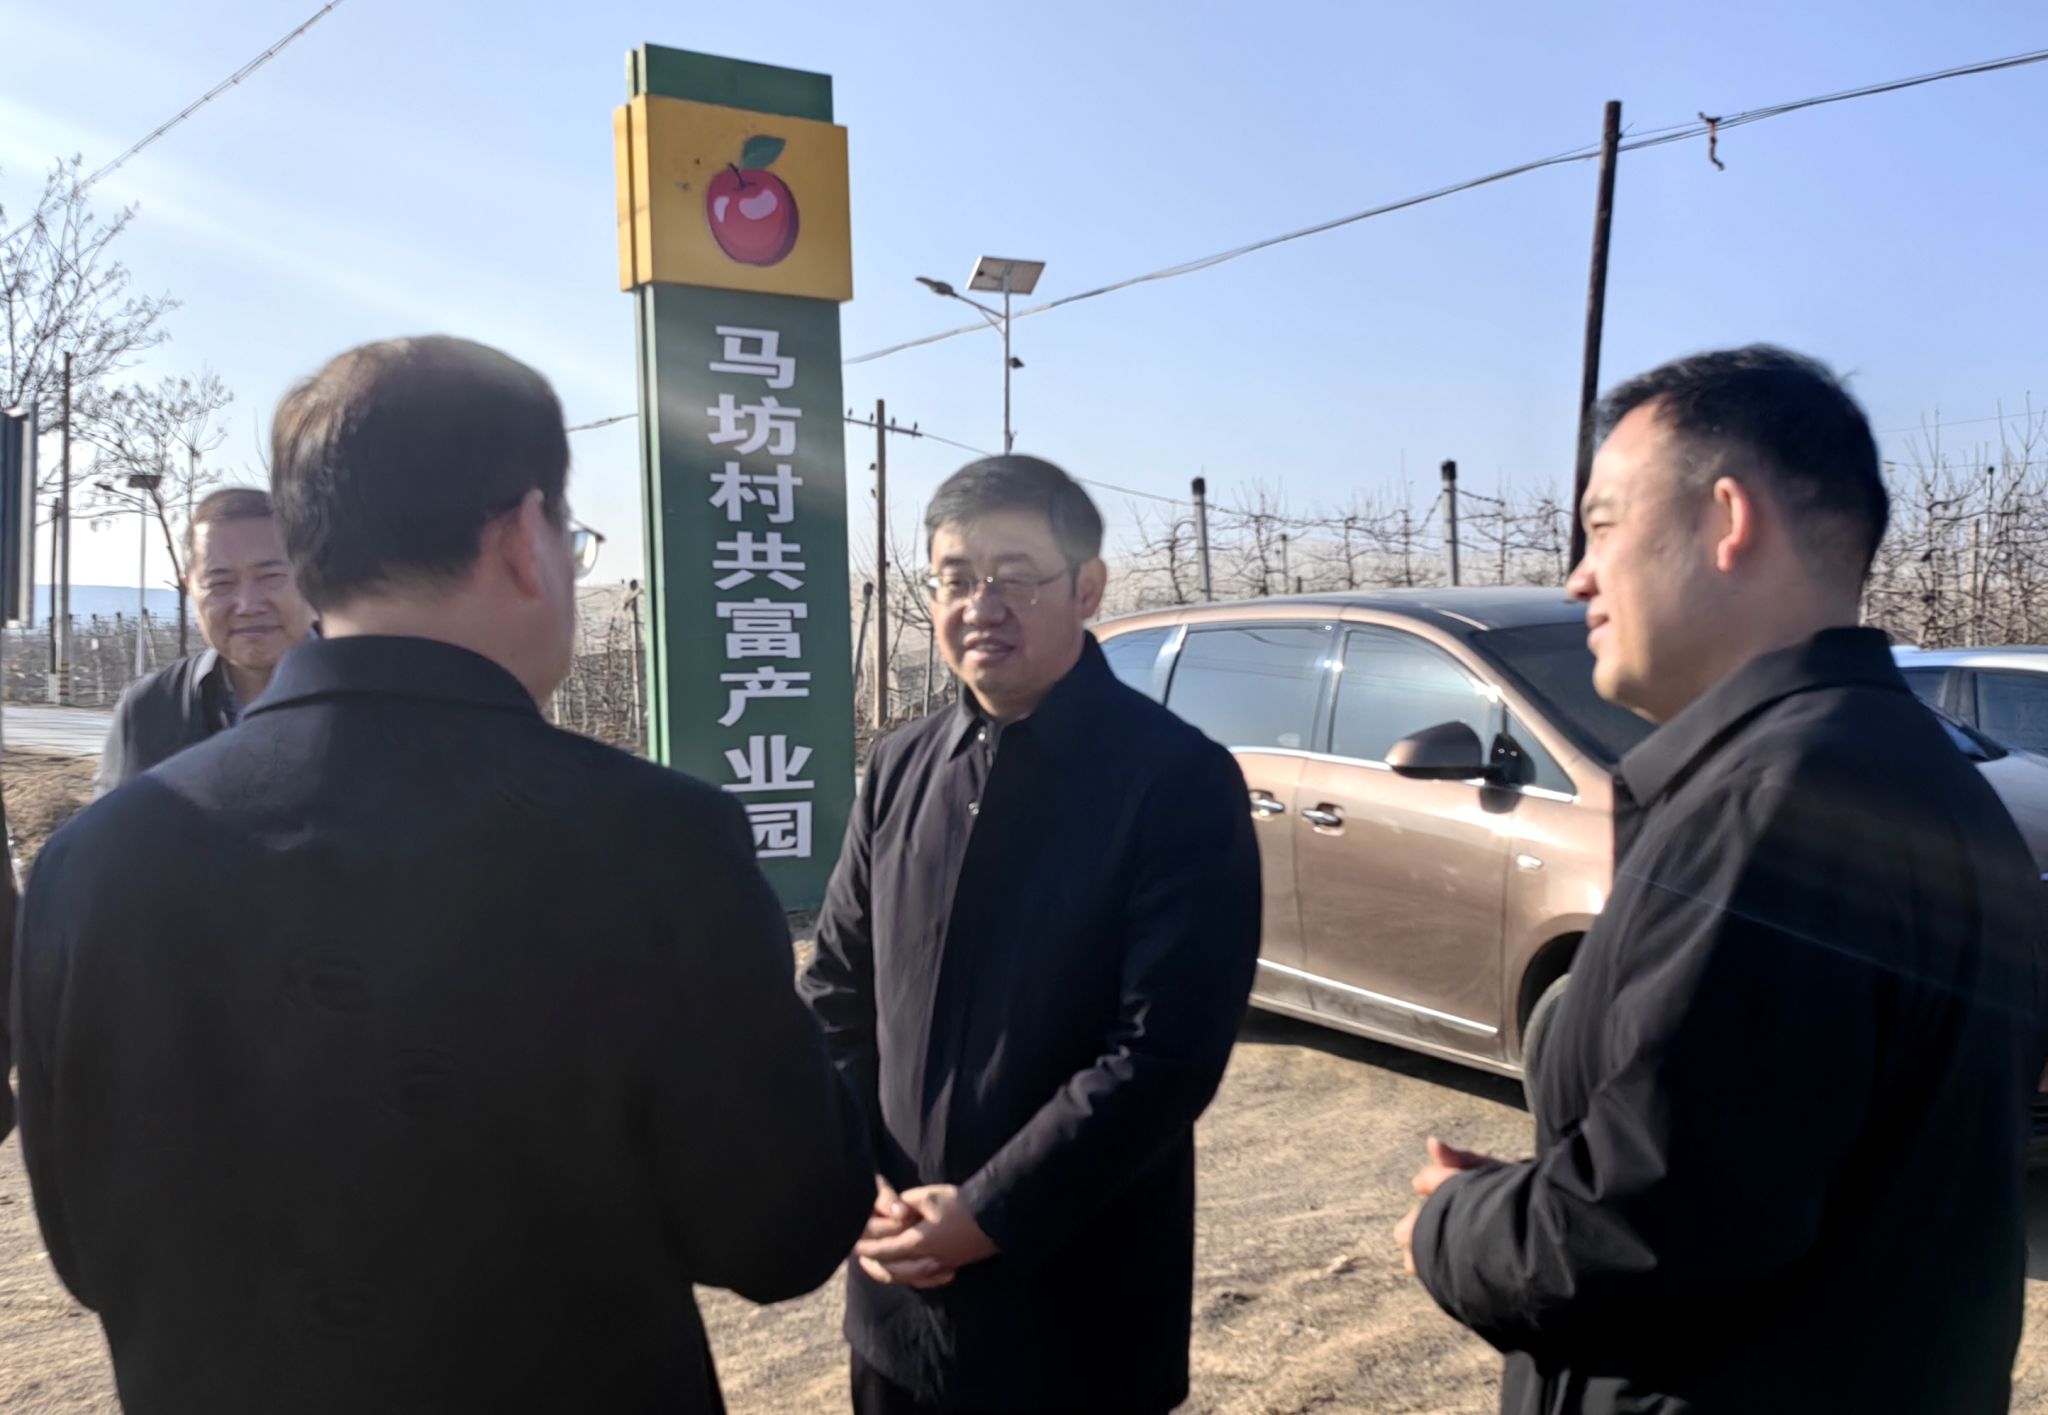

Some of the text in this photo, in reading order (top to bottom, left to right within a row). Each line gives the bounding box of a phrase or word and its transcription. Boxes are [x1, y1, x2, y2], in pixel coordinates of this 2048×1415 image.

[706, 325, 815, 859] 马坊村共富产业园
